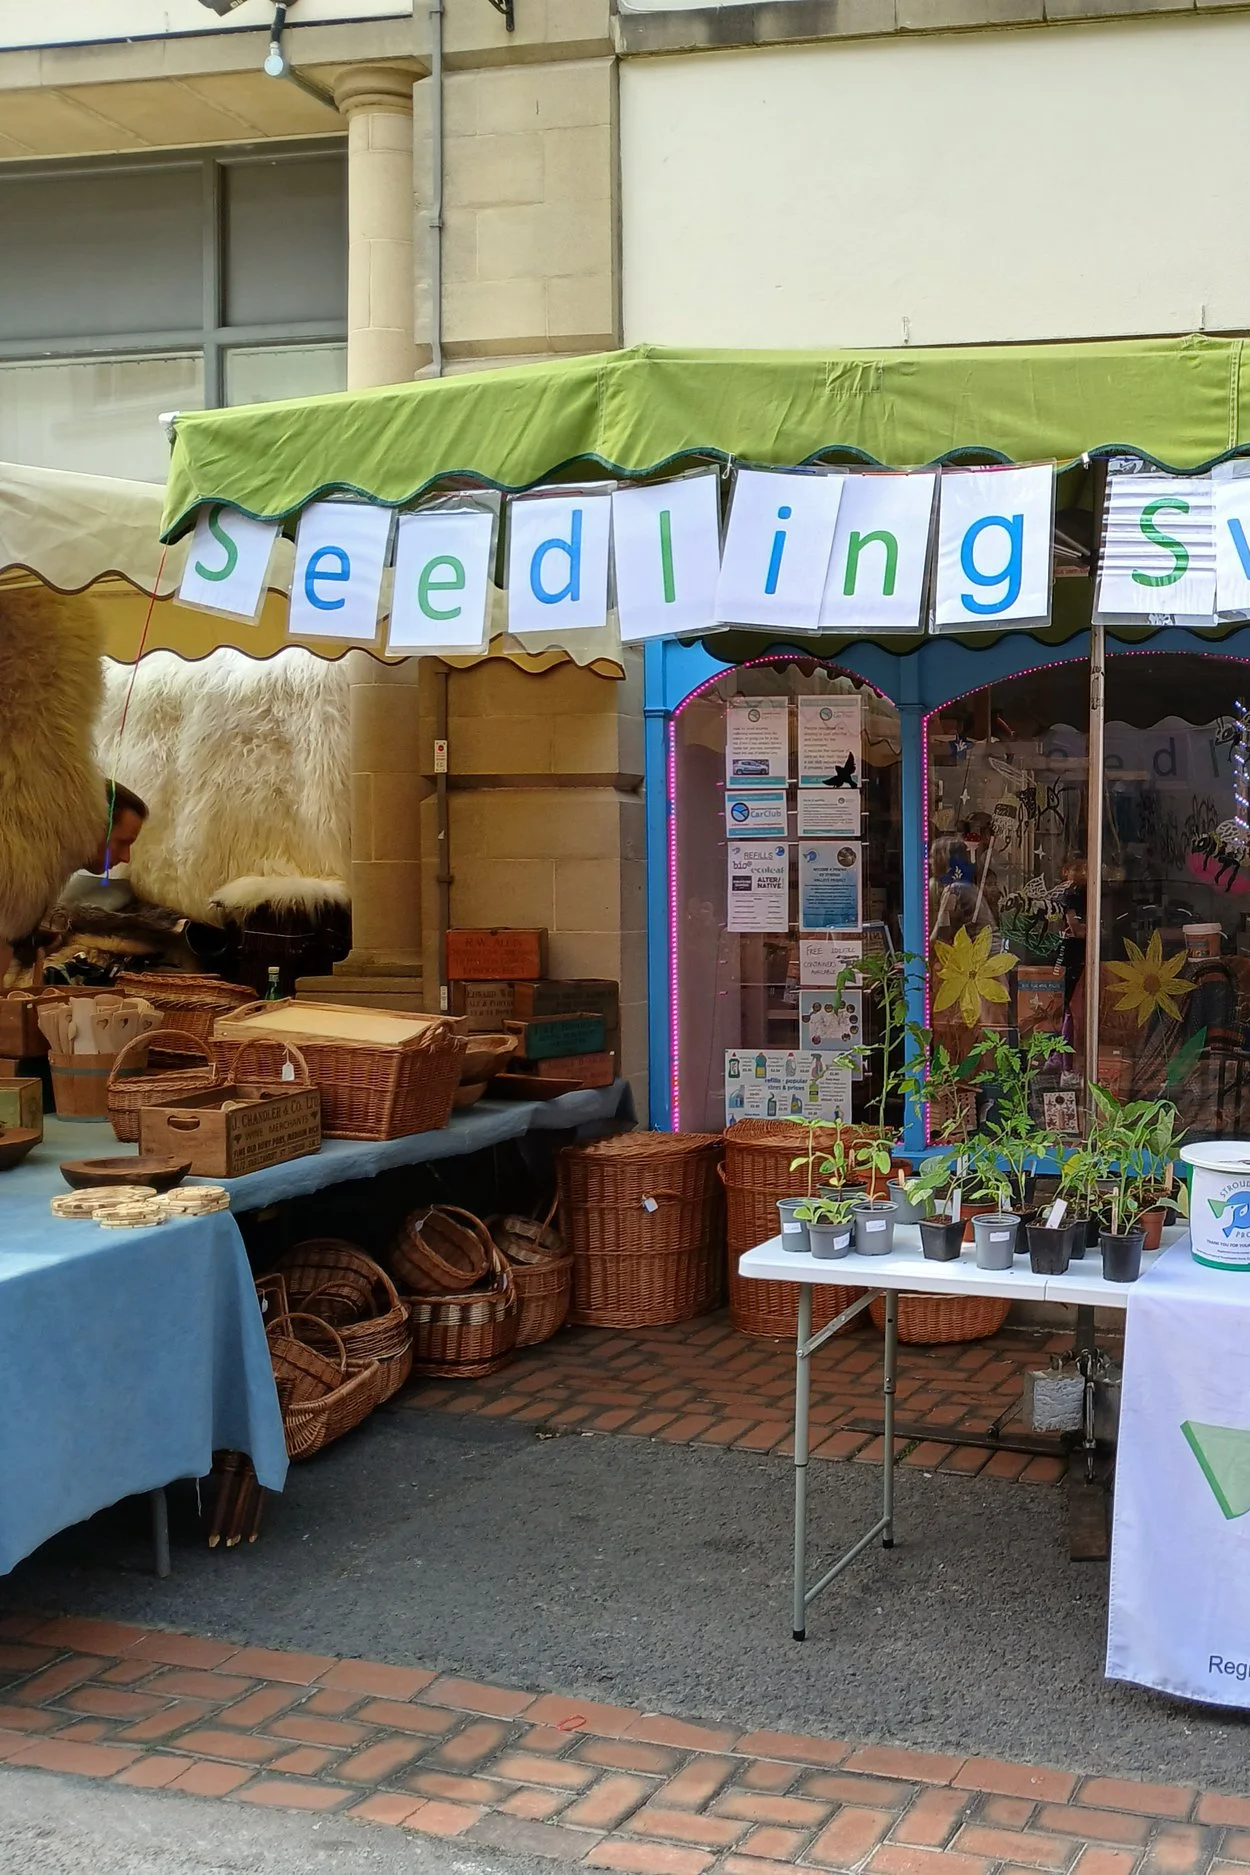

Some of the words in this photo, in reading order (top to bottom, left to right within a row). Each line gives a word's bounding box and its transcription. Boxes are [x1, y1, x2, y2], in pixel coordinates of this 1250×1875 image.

[195, 503, 1025, 621] Seedling
[750, 810, 782, 818] CarClub
[744, 851, 774, 860] REFILLS
[806, 945, 823, 956] FREE
[241, 1106, 281, 1128] CHANDLER
[268, 1114, 309, 1133] MERCHANTS
